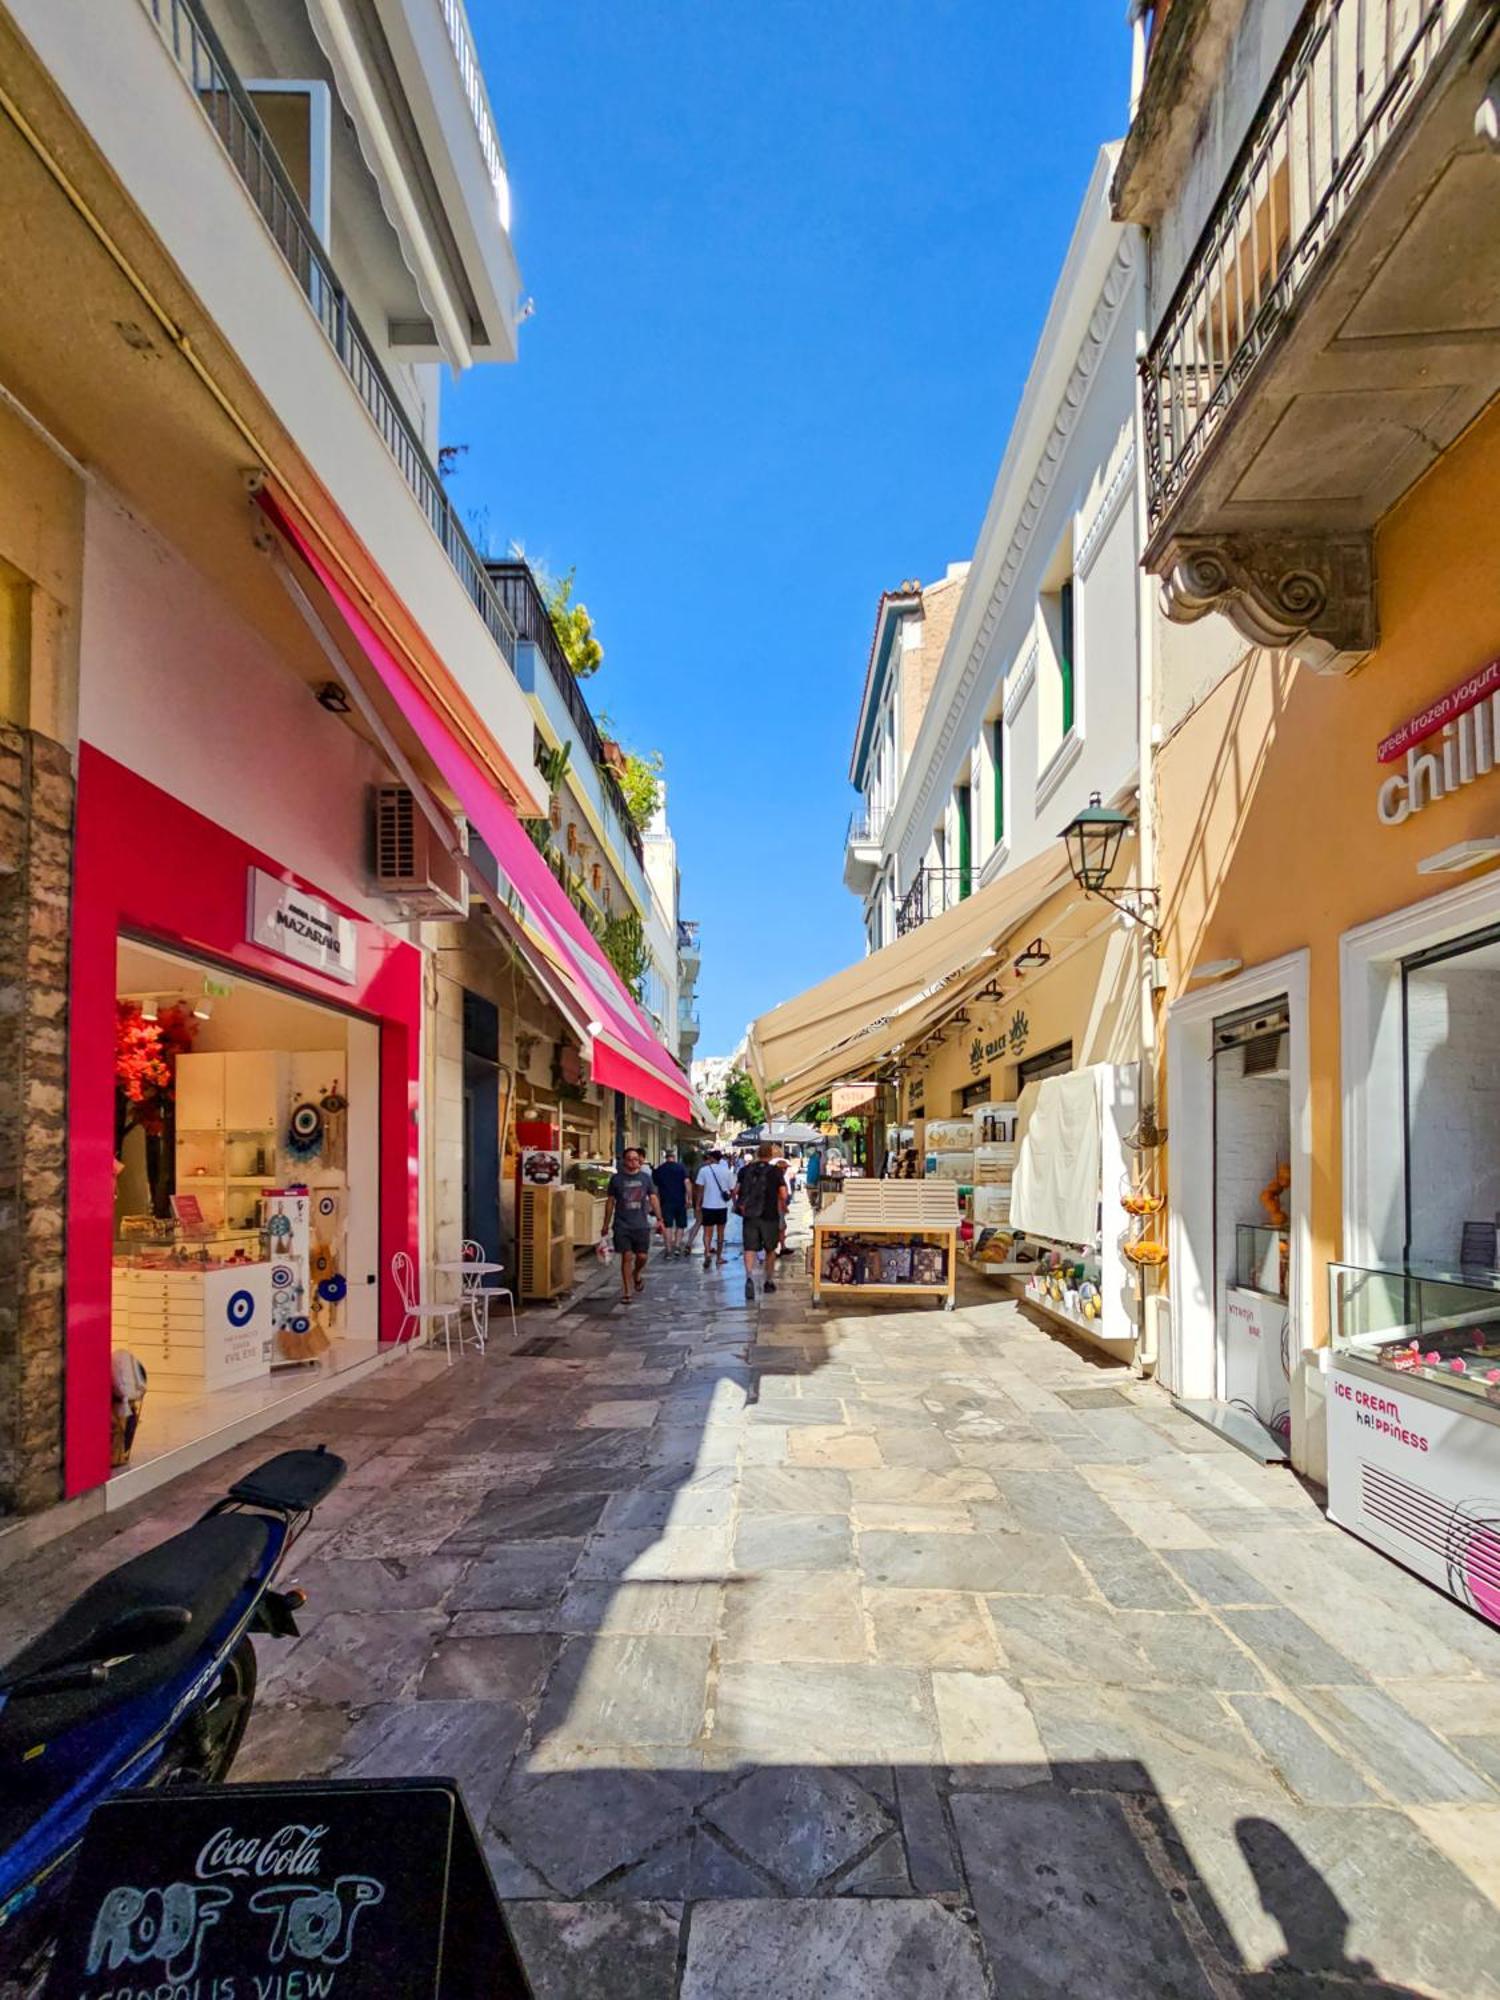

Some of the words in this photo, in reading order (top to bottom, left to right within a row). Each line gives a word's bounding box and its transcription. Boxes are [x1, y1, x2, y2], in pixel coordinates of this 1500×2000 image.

[1377, 687, 1500, 826] chill
[1378, 727, 1409, 761] greek
[1411, 698, 1450, 735] frozen
[1452, 662, 1499, 709] yogurt
[85, 1881, 234, 1985] ROOF
[248, 1874, 386, 1964] TOP
[77, 1976, 236, 2000] CROPOLIS
[252, 1970, 335, 2000] VIEW
